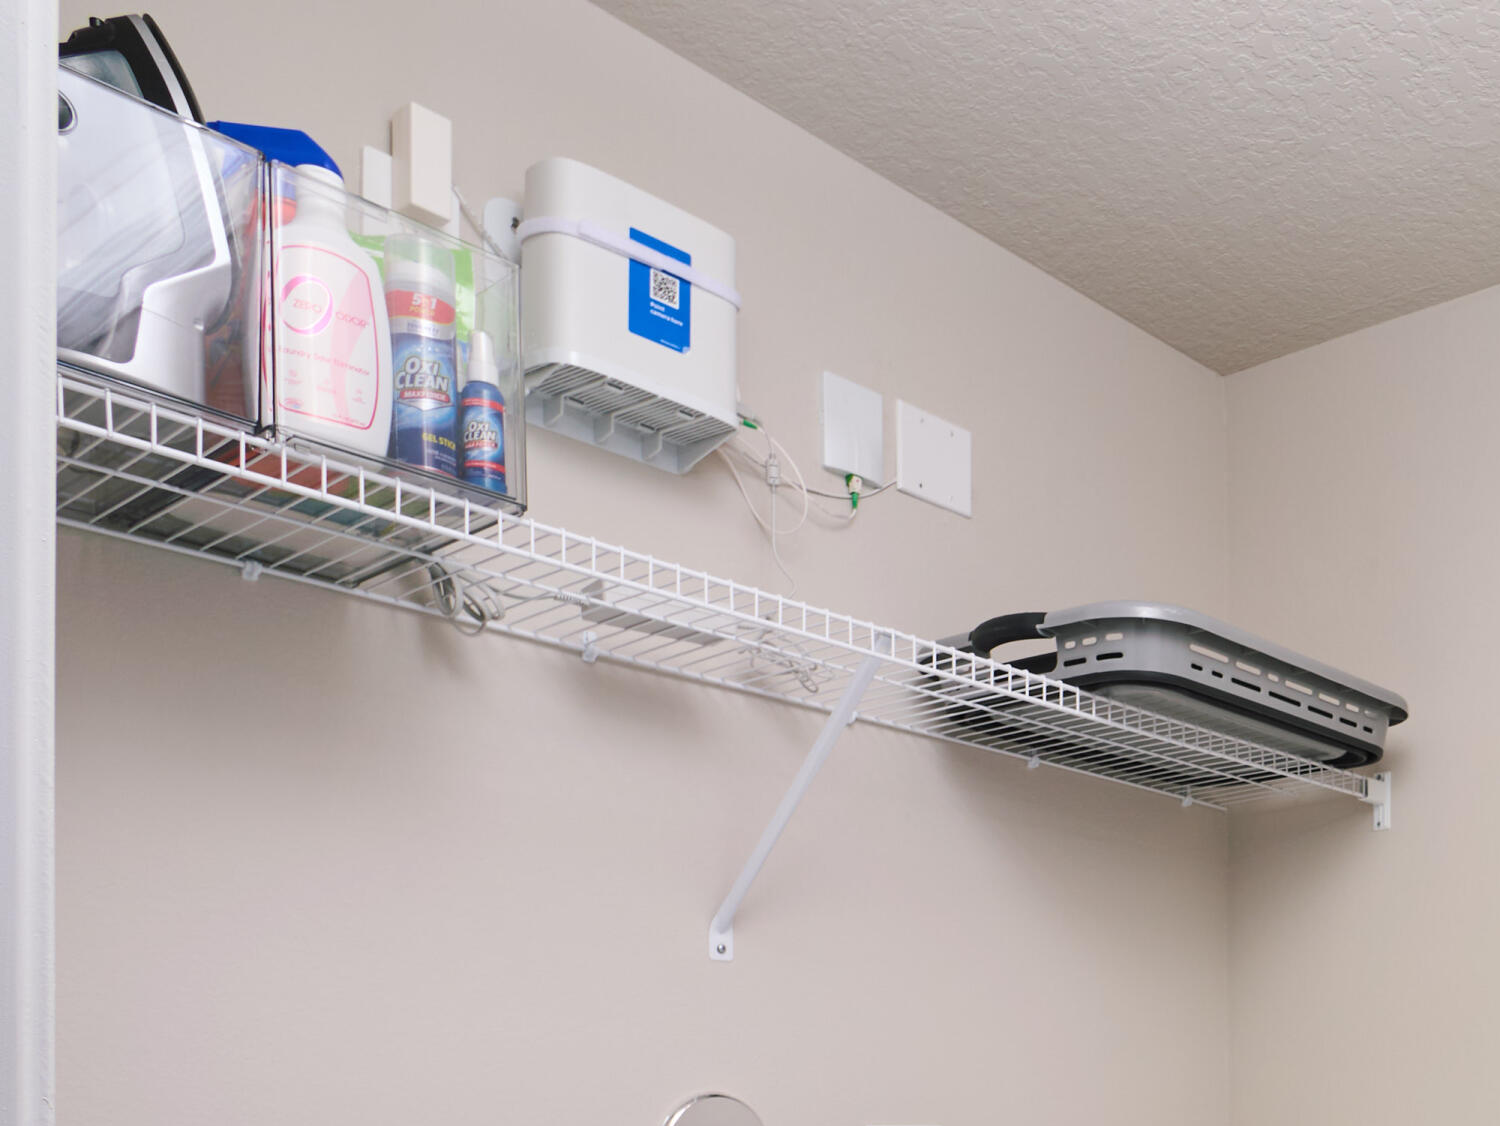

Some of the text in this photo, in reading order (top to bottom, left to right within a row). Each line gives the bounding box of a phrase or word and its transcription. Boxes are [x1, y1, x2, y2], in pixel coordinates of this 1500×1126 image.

[405, 356, 440, 376] OXI
[395, 371, 449, 392] CLEAN
[468, 421, 490, 433] OXI
[464, 431, 496, 442] CLEAN
